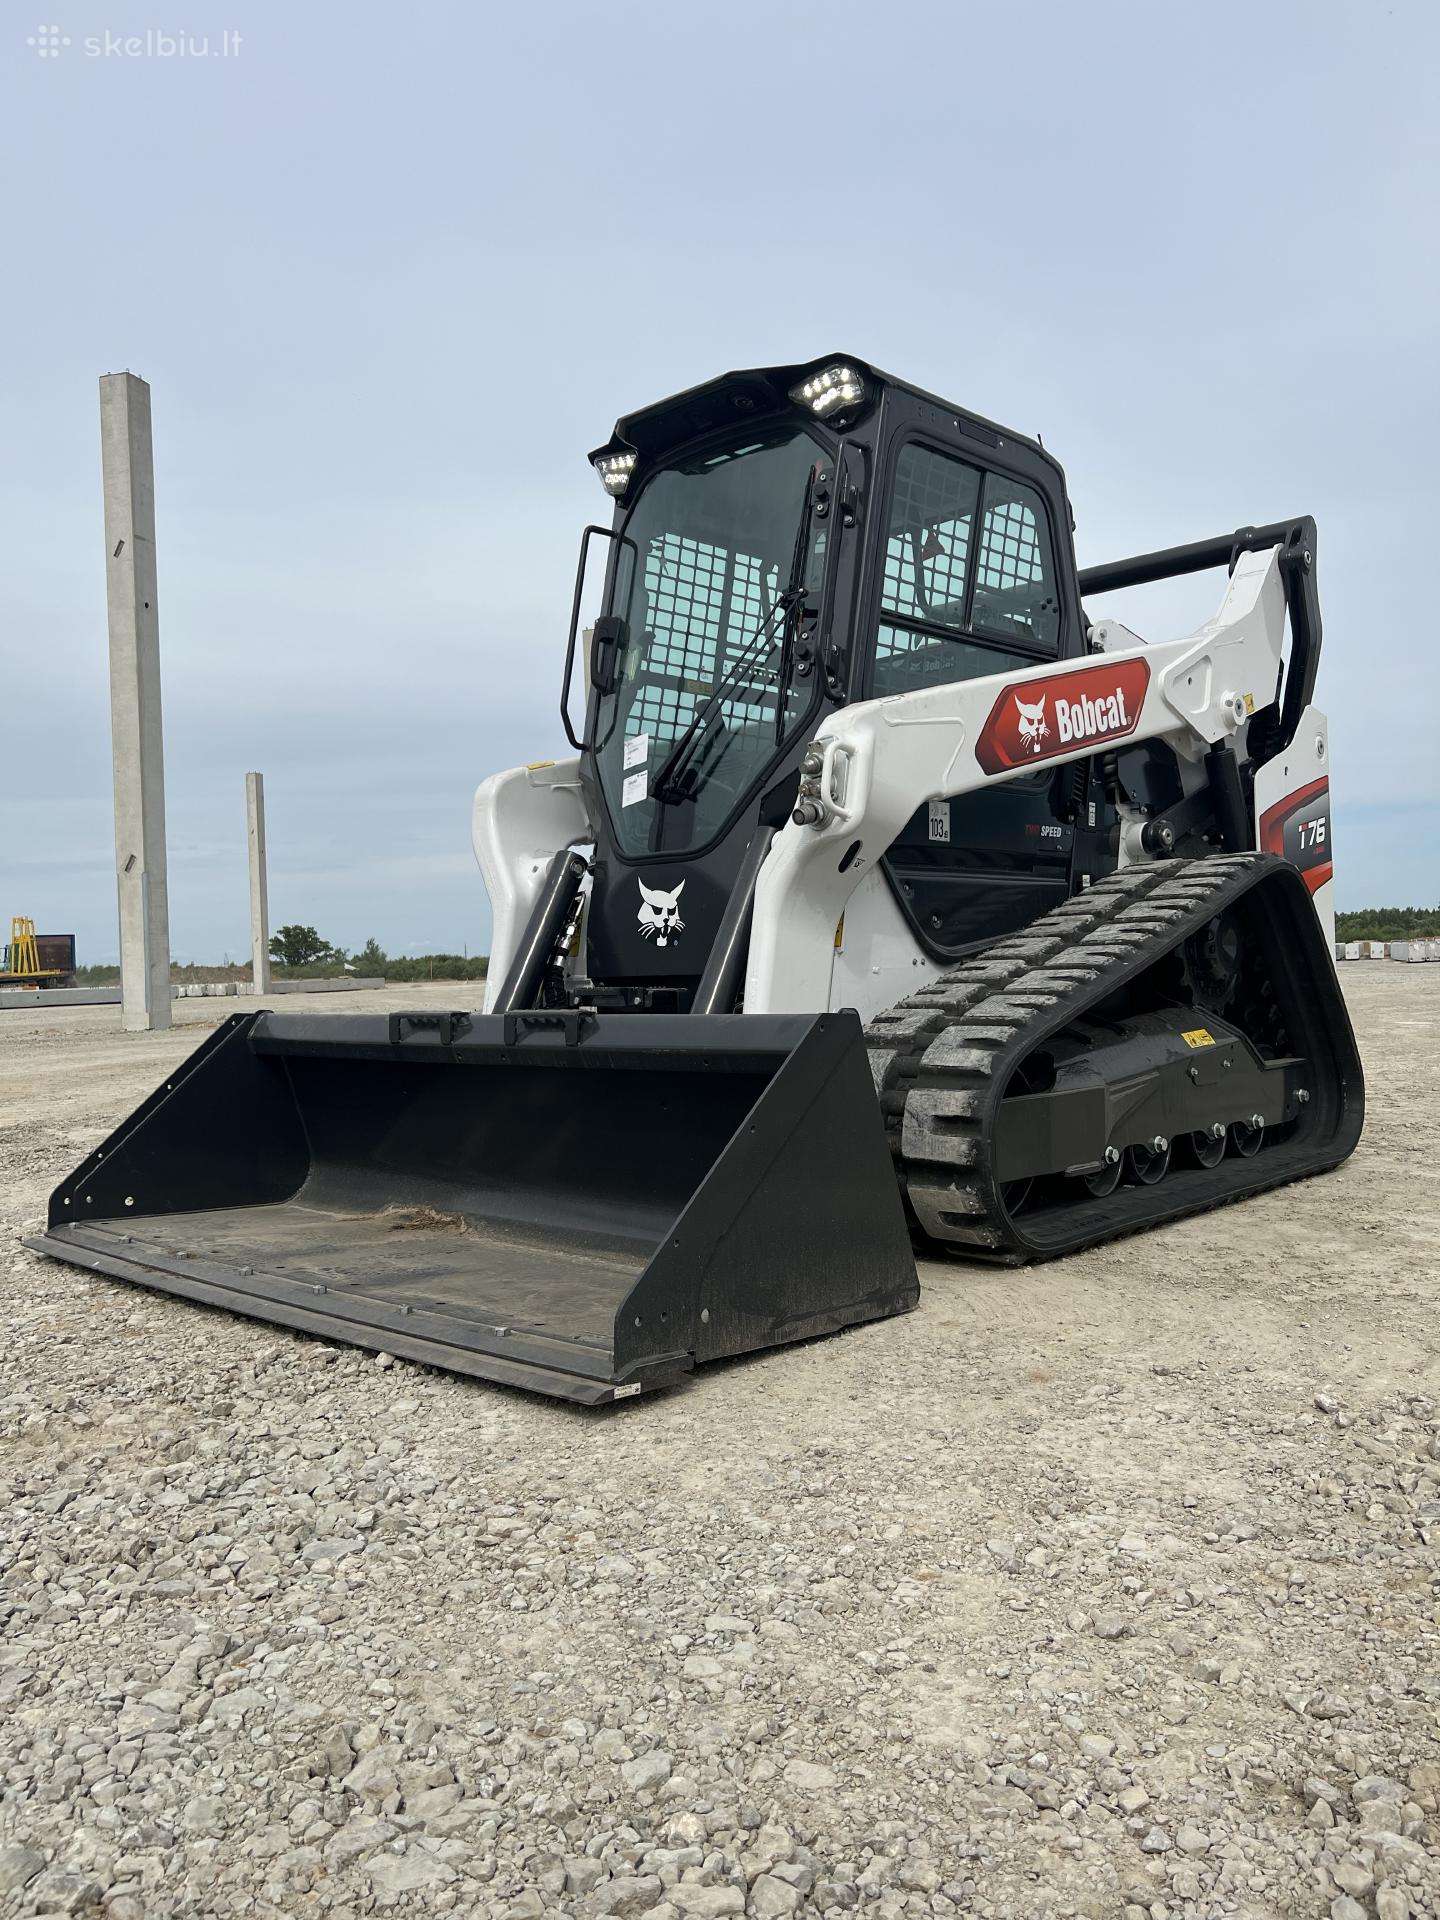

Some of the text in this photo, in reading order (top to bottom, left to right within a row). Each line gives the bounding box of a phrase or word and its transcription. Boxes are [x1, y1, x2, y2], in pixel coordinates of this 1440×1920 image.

[1055, 687, 1127, 743] Bobcat
[931, 818, 944, 838] 103
[1040, 825, 1062, 838] SPEED
[1299, 817, 1326, 850] T76
